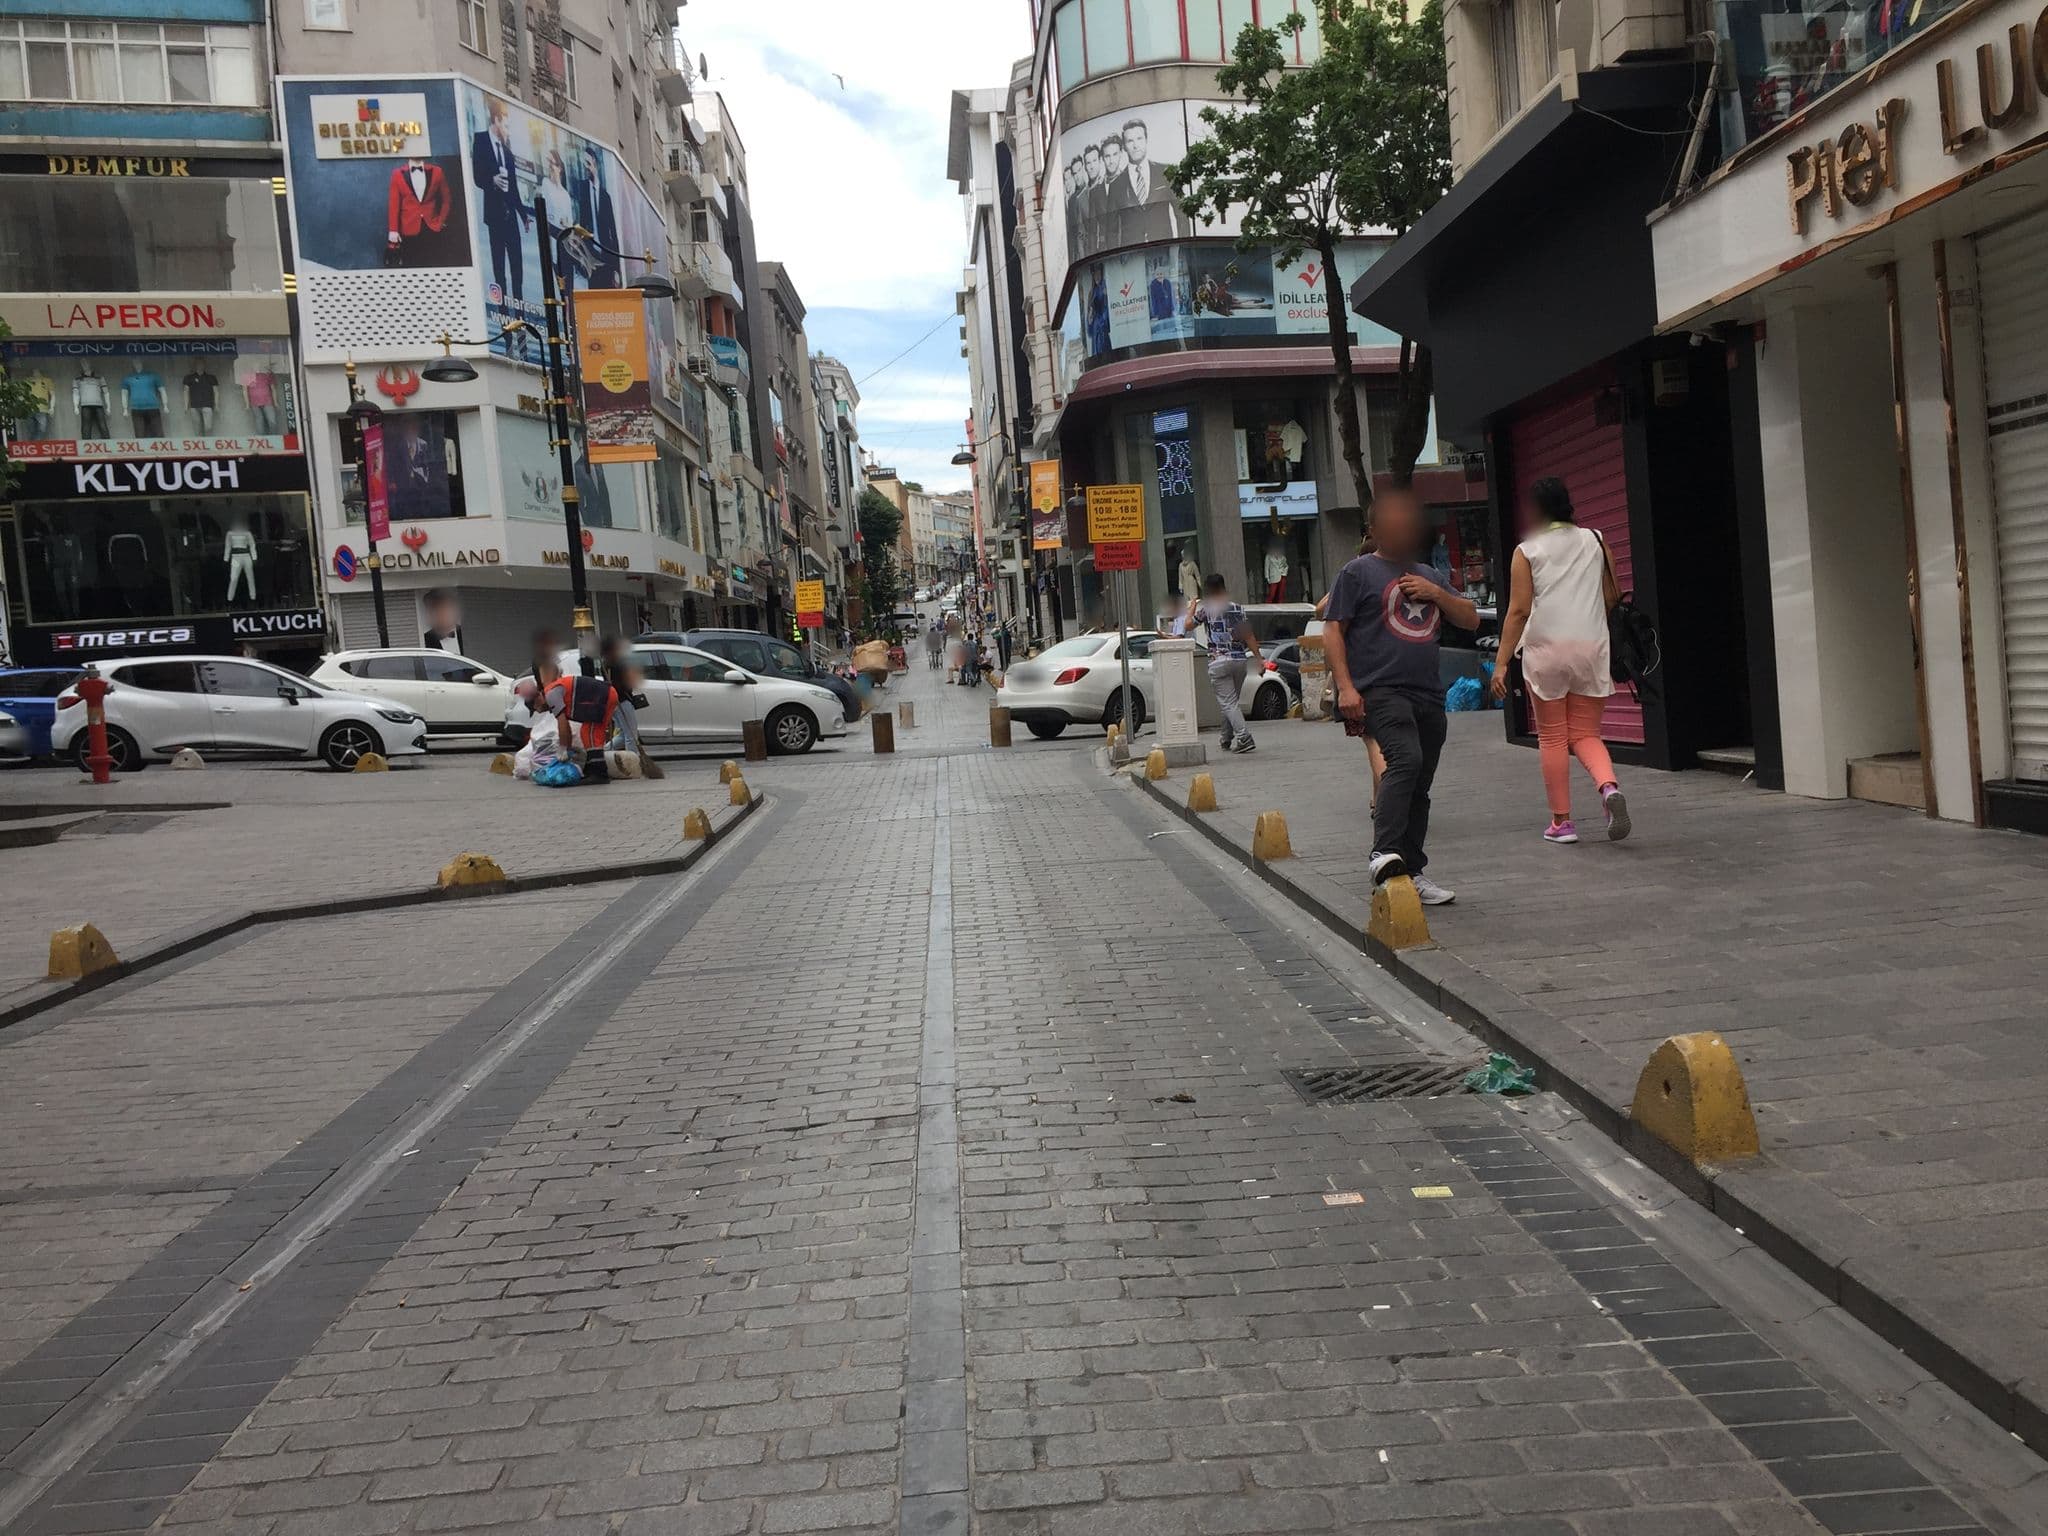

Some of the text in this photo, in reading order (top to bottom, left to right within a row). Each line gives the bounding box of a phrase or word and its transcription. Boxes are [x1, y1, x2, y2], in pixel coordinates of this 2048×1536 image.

[319, 123, 351, 138] BIG
[341, 138, 406, 154] GROUP
[48, 154, 190, 177] DEMFUR
[1303, 293, 1352, 304] LEAR
[1287, 307, 1329, 319] exclus
[56, 342, 236, 354] TONY MONTANA
[284, 383, 297, 429] PERON
[12, 438, 274, 456] BIG SIZE 2XL 3XL 4XL 5XL 6XL 7XL
[74, 460, 239, 493] KLYUCH
[417, 548, 500, 568] MILANO
[542, 550, 630, 570] MAR MILANO
[232, 612, 322, 634] KLYUCH
